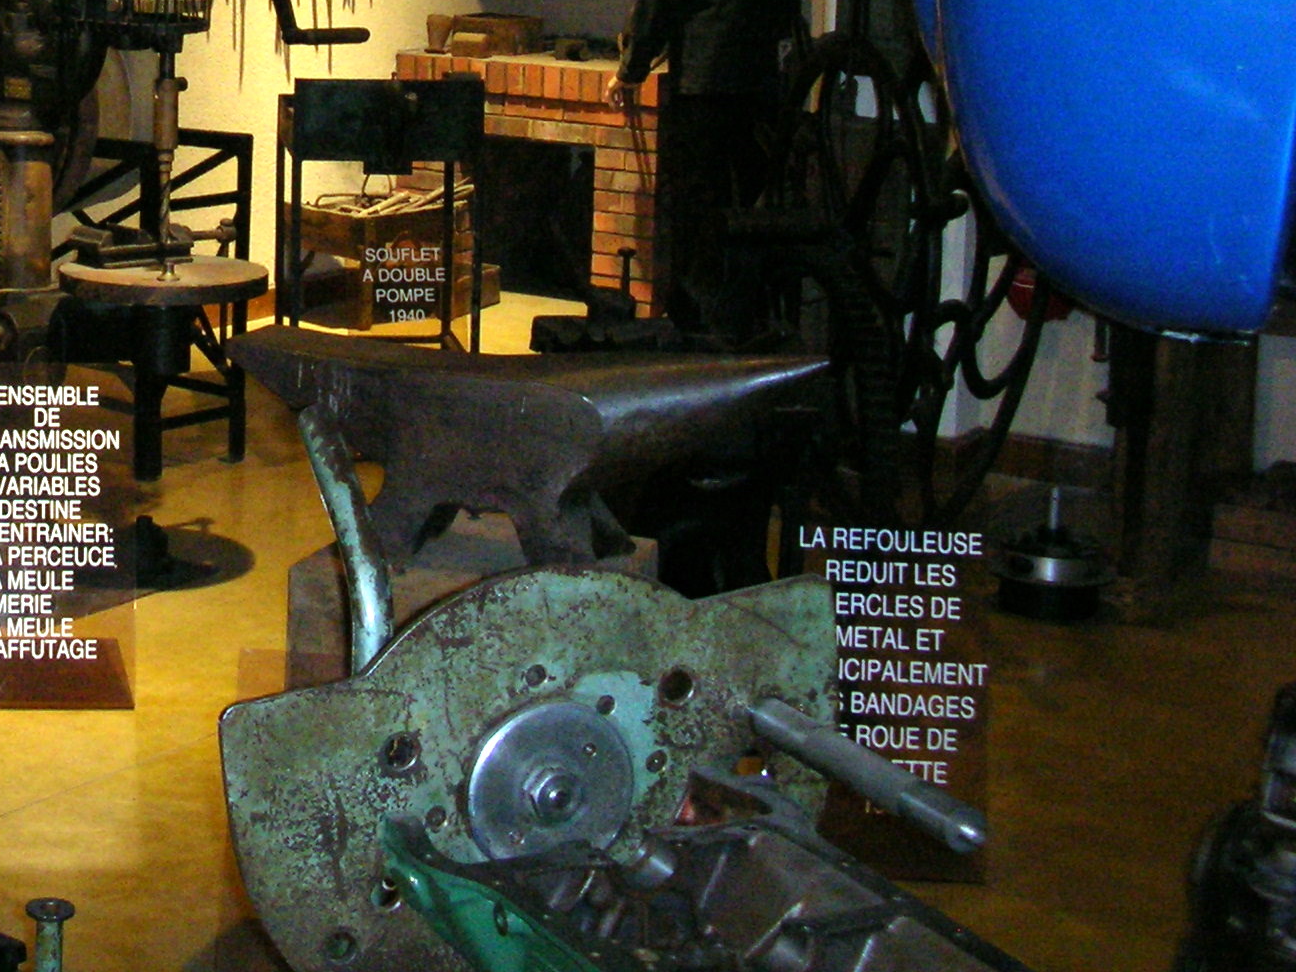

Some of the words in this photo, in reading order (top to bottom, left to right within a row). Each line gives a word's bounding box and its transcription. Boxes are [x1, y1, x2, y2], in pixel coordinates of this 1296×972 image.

[365, 247, 440, 262] SOUFLET
[362, 268, 374, 282] A
[378, 267, 446, 282] DOUBLE
[375, 288, 435, 303] POMPE
[389, 309, 425, 323] 1940
[34, 407, 61, 427] DE
[15, 453, 98, 473] POULIES
[799, 526, 826, 548] LA
[833, 527, 983, 555] REFOULEUSE
[7, 570, 75, 590] MEULE
[826, 559, 908, 584] REDUIT
[914, 563, 956, 587] LES
[835, 592, 924, 618] ERCLES
[930, 597, 961, 620] DE
[6, 617, 74, 637] MEULE
[836, 625, 910, 650] METAL
[916, 629, 945, 651] ET
[850, 691, 976, 719] BANDAGES
[856, 724, 921, 749] ROUE
[927, 728, 958, 751] DE
